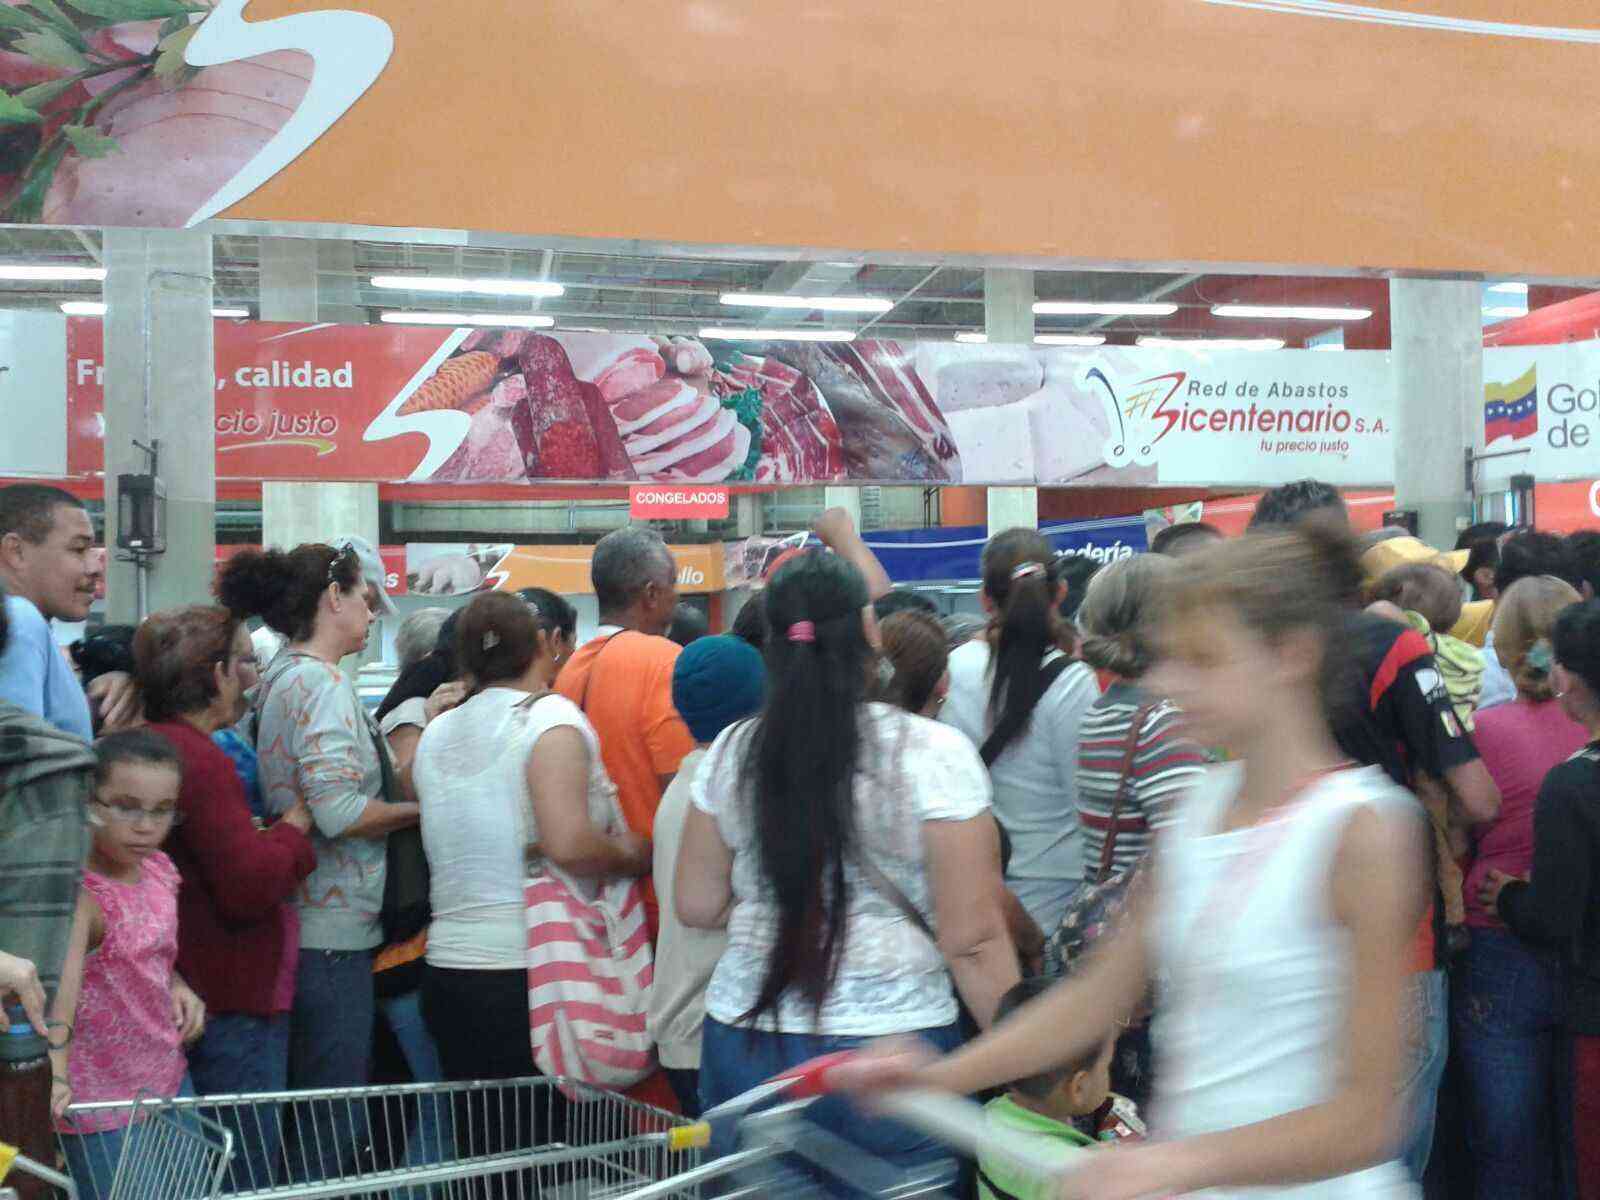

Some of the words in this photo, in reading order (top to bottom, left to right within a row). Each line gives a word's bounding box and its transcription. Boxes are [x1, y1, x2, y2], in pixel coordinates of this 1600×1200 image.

[234, 360, 353, 388] calidad
[1187, 380, 1228, 397] Red
[1235, 381, 1259, 398] de
[1268, 382, 1349, 398] Abastos
[1547, 379, 1600, 415] Go
[268, 408, 338, 440] justo
[1354, 418, 1390, 433] S.A.
[1547, 418, 1590, 448] de
[1260, 439, 1272, 452] tu
[1276, 440, 1317, 455] precio
[1319, 438, 1349, 454] justo
[635, 492, 726, 505] CONGELADOS
